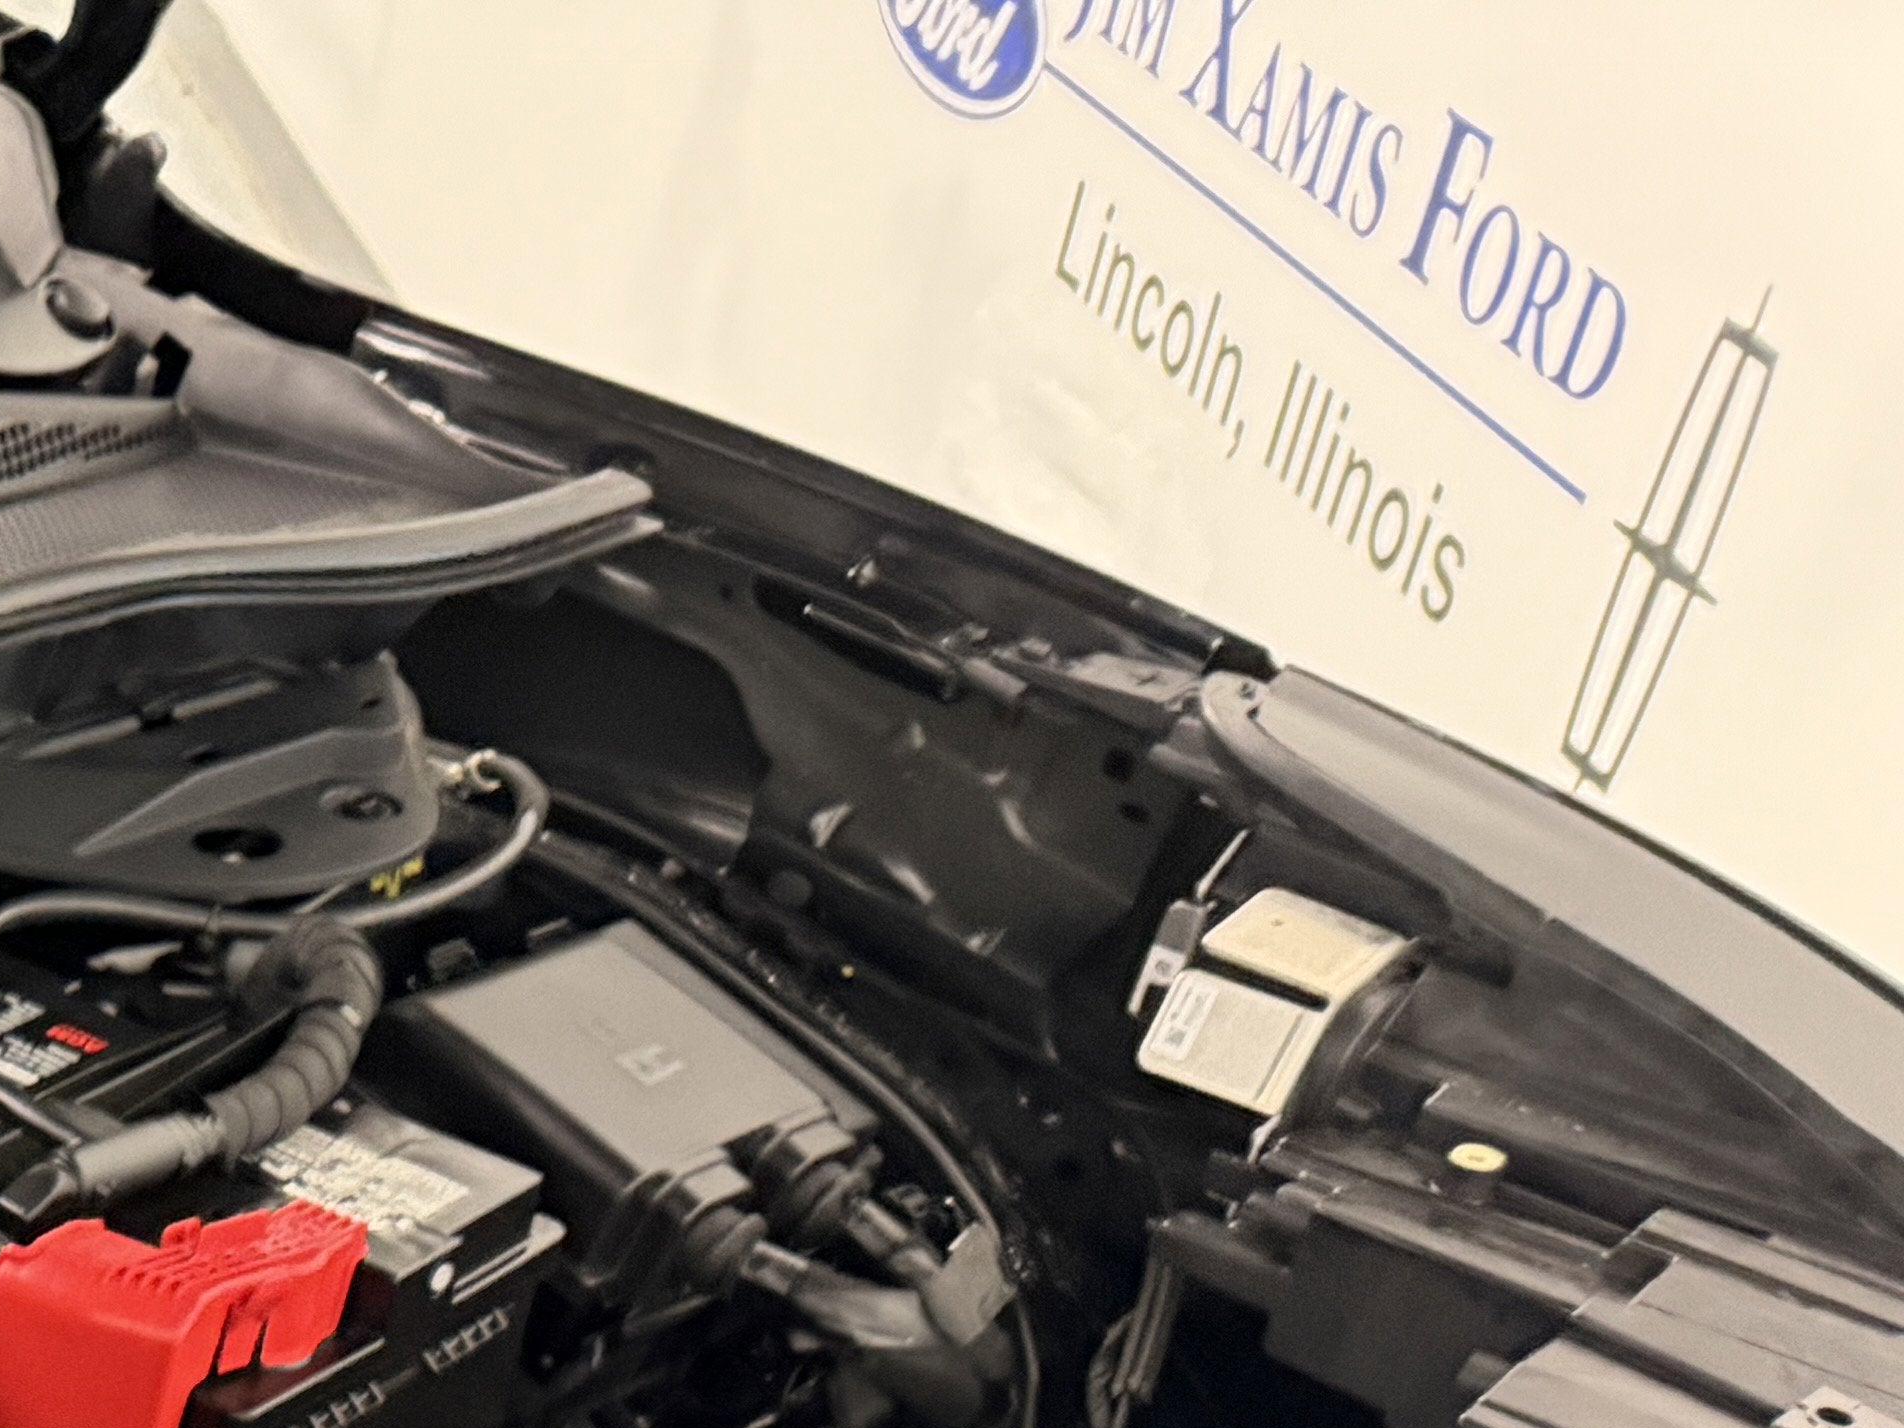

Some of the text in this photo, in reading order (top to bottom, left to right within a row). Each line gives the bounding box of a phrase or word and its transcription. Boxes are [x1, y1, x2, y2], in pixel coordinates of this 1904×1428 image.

[893, 0, 1017, 91] ord
[1178, 0, 1403, 238] XAMIS
[1397, 106, 1629, 401] FORD
[1054, 180, 1467, 625] Lincoln, Illinois
